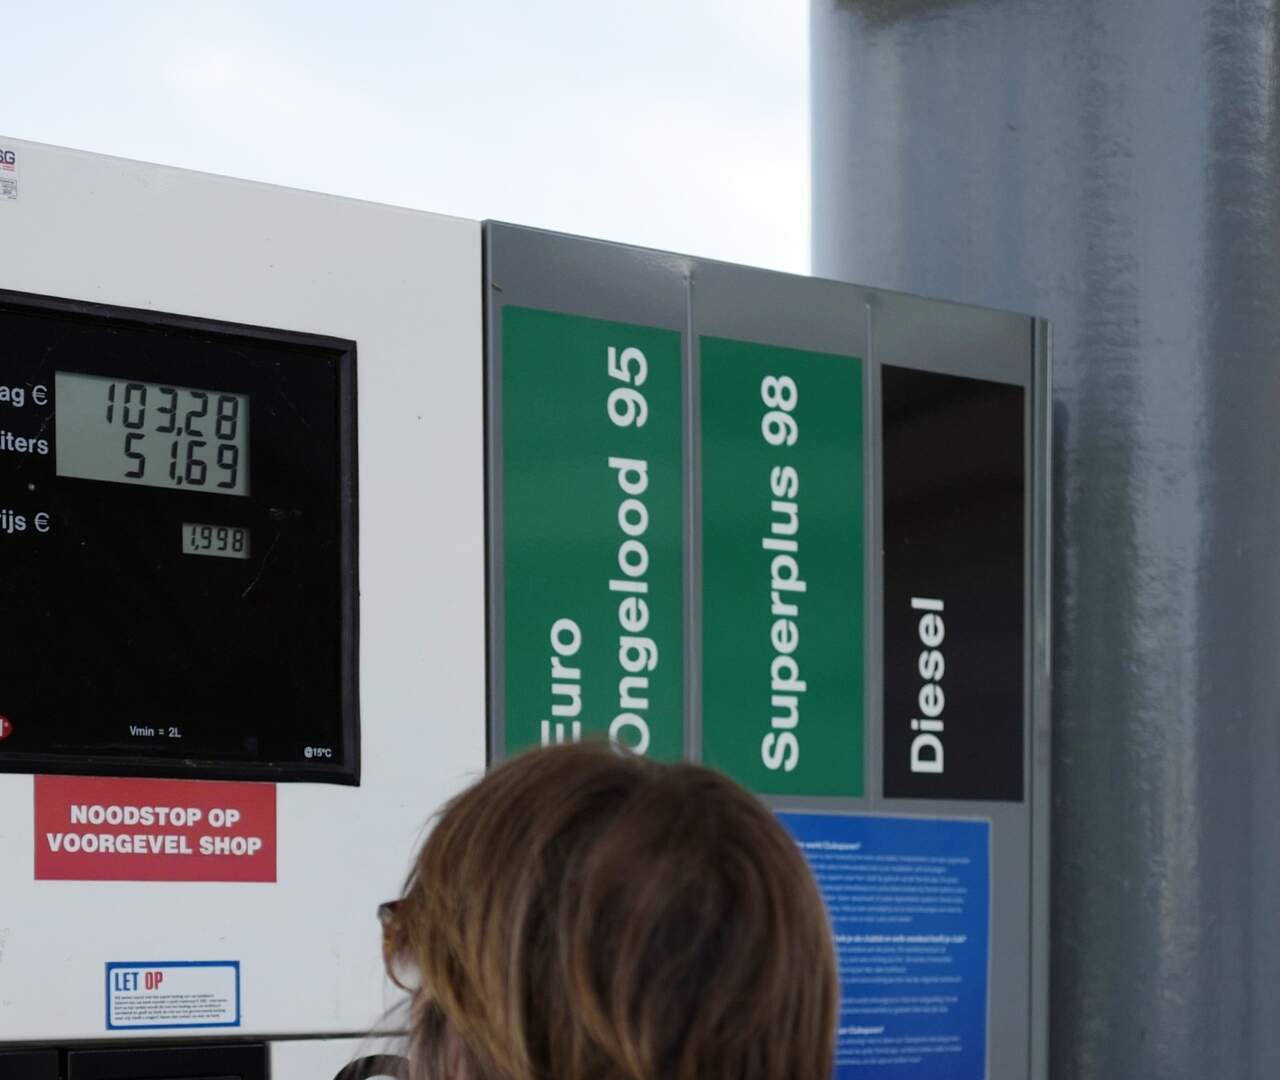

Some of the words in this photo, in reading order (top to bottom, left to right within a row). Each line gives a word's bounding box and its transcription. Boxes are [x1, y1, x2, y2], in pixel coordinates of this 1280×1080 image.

[32, 385, 48, 406] €
[106, 383, 239, 441] 103,28
[608, 346, 649, 428] 95
[761, 375, 799, 446] 98
[124, 432, 239, 489] 51,69
[34, 512, 51, 532] €
[191, 526, 244, 552] 1,998
[608, 457, 659, 756] Ongelood
[761, 465, 807, 773] Superplus
[541, 617, 582, 748] Euro
[910, 597, 946, 774] Diesel
[129, 725, 155, 737] Vmin
[168, 727, 182, 738] 2L
[46, 832, 193, 855] VOORGEVEL
[199, 836, 262, 856] SHOP
[70, 804, 203, 827] NOODSTOP
[207, 808, 241, 828] OP
[115, 972, 139, 992] LET
[144, 971, 163, 991] OP
